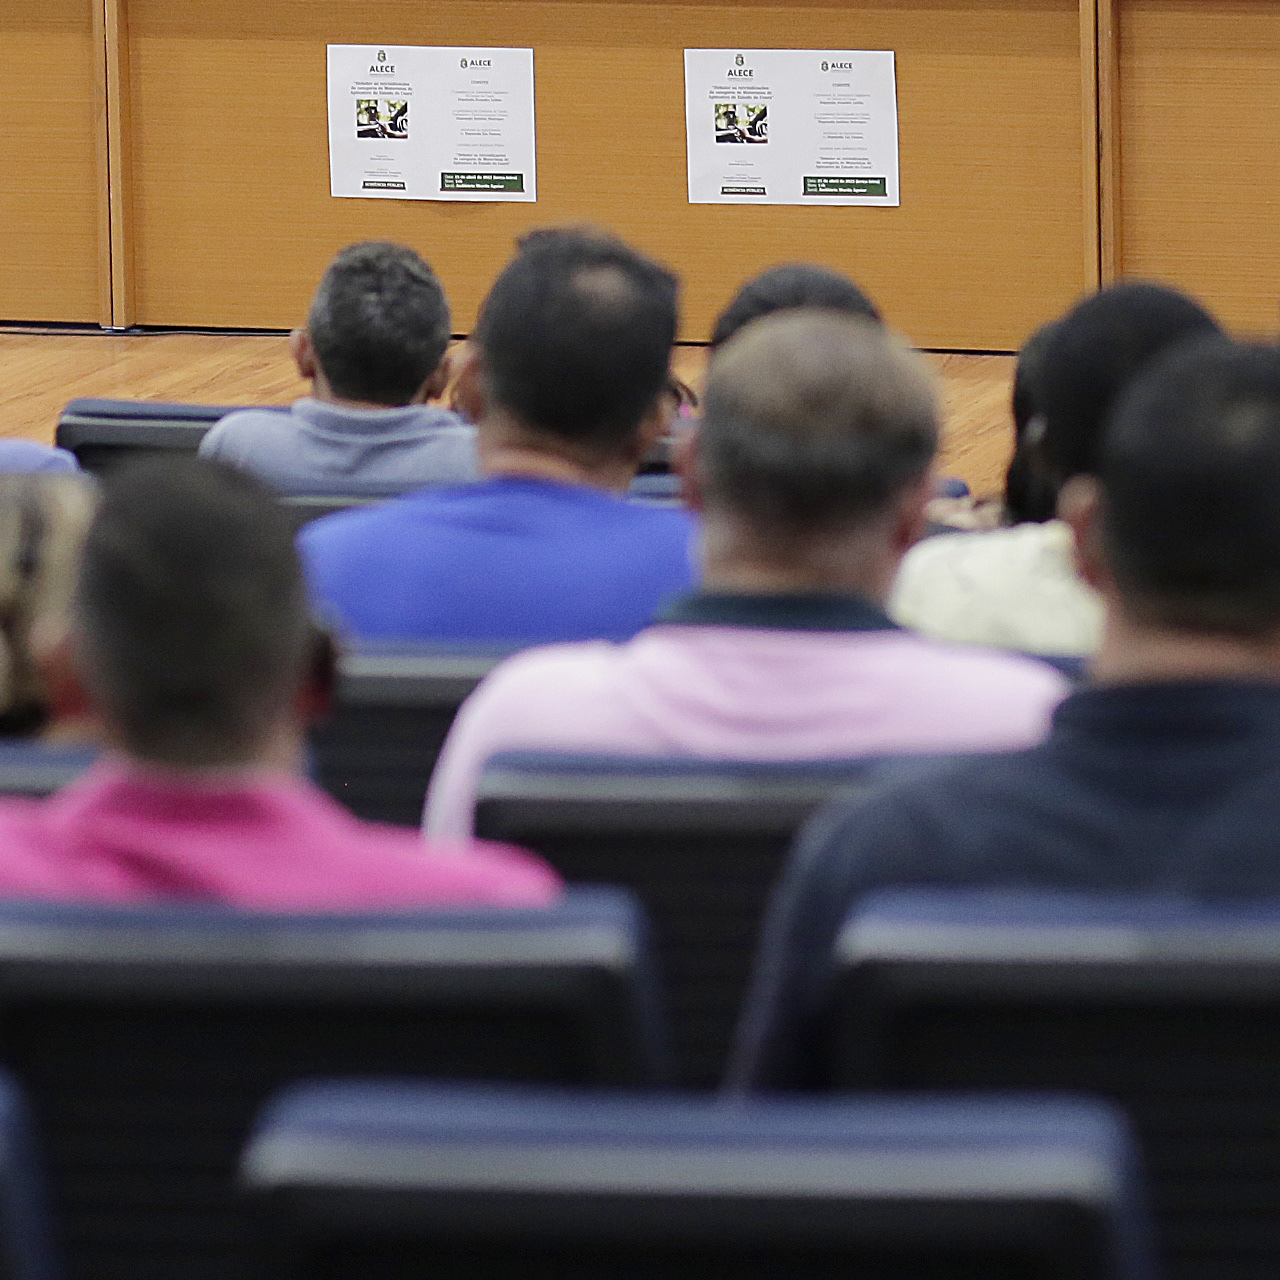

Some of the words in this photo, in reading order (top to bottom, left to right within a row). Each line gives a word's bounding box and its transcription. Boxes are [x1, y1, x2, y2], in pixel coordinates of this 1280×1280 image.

[470, 59, 492, 67] ALECE
[369, 65, 395, 73] ALECE
[727, 69, 754, 77] ALECE
